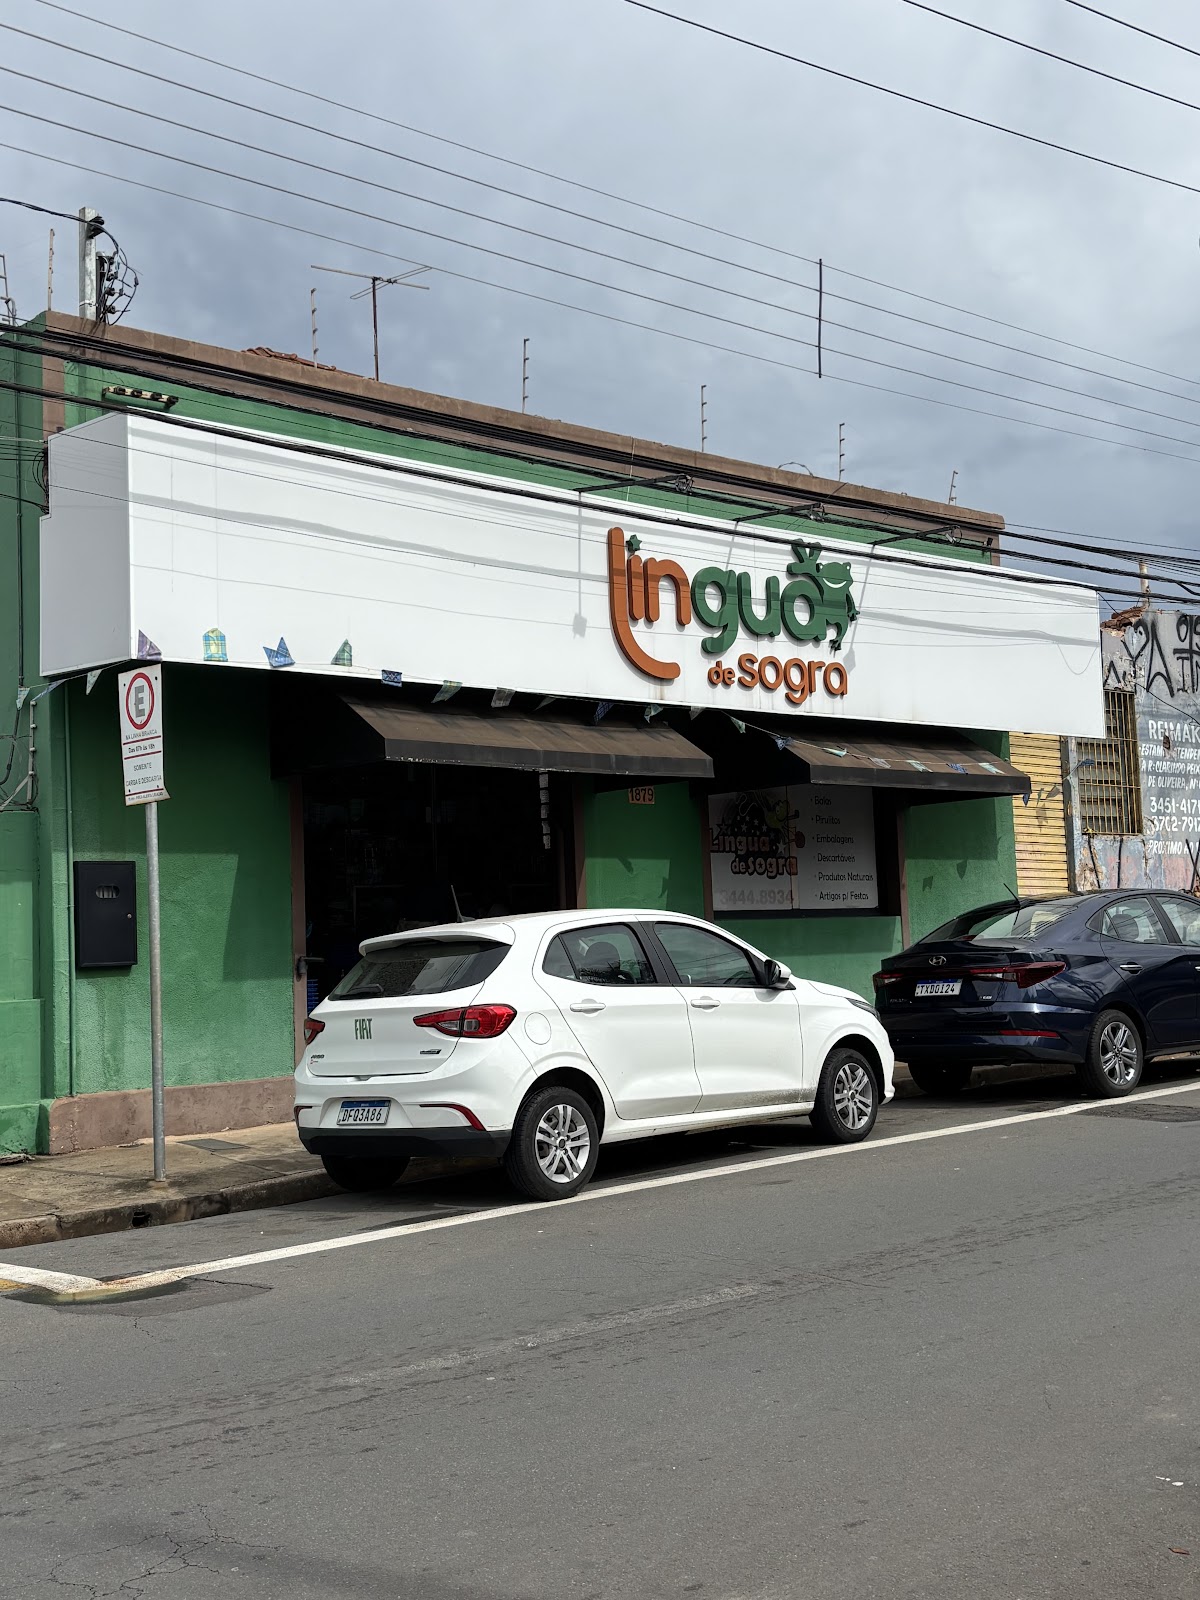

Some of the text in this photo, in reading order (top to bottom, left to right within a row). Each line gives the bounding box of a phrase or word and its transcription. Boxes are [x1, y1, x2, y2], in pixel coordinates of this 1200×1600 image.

[708, 653, 848, 704] de sogra
[134, 684, 146, 719] E
[133, 761, 152, 772] SOMENTE
[126, 779, 138, 787] CARGA
[141, 774, 162, 785] DESCARGA
[1148, 775, 1156, 788] DE
[629, 787, 654, 803] 1879
[814, 795, 832, 806] Balas
[815, 814, 841, 825] Pirulitos
[816, 833, 854, 845] Embalagens
[817, 852, 856, 863] Descartáveis
[731, 855, 798, 879] de sogra
[818, 871, 874, 881] Produtos Naturais
[819, 890, 841, 902] Artigos
[850, 890, 869, 900] Festas
[354, 1018, 373, 1040] FIAT
[342, 1108, 382, 1122] DFQ3A86
